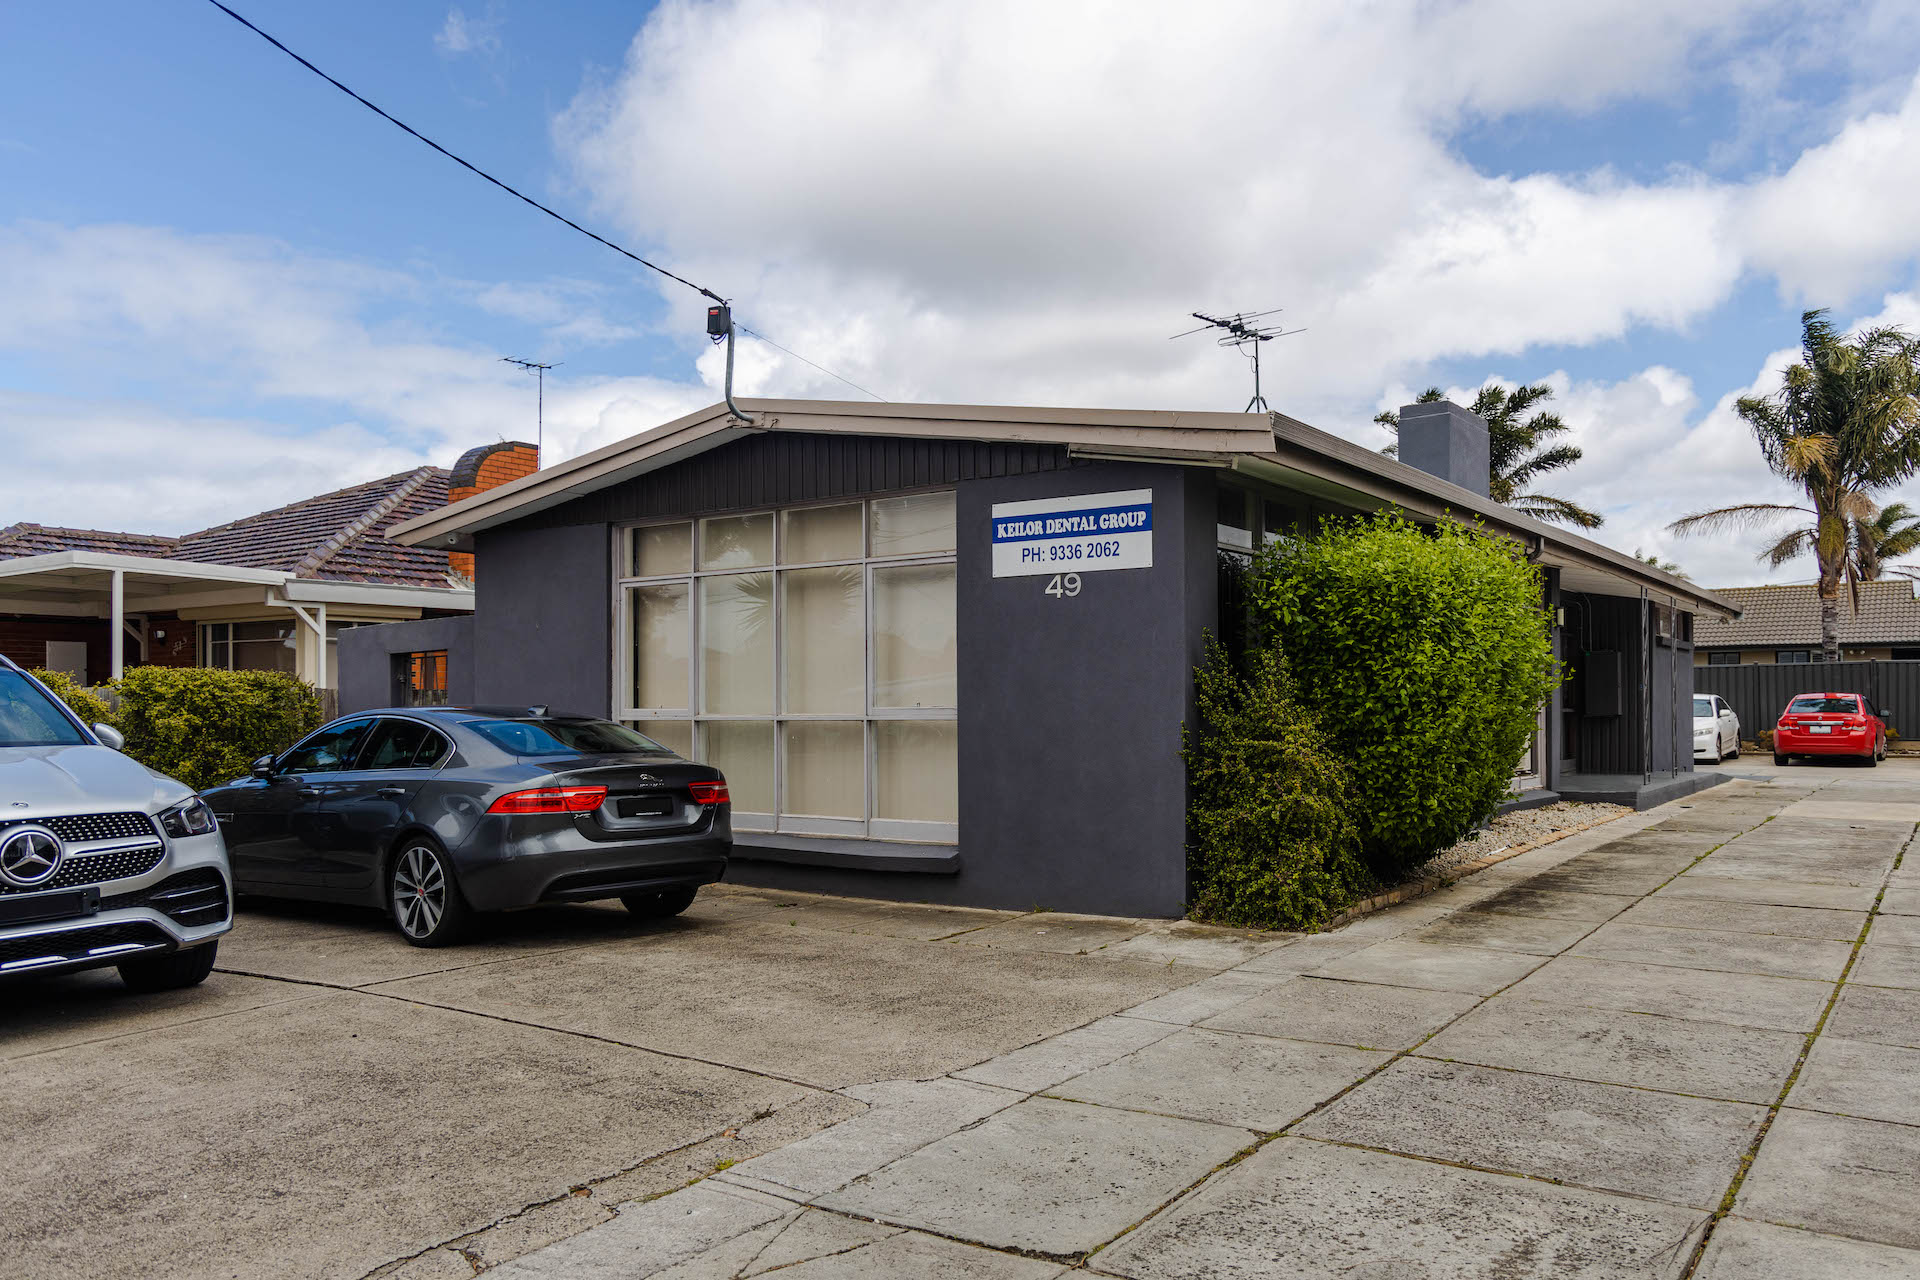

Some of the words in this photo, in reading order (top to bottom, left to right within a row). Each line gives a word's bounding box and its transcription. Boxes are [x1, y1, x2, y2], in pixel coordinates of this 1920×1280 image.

[997, 519, 1043, 538] KEILOR
[1046, 515, 1097, 534] DENTAL
[1100, 510, 1147, 530] GROUP
[1022, 546, 1045, 563] PH:
[1050, 543, 1082, 561] 9336
[1086, 541, 1120, 558] 2062
[1044, 572, 1082, 599] 49
